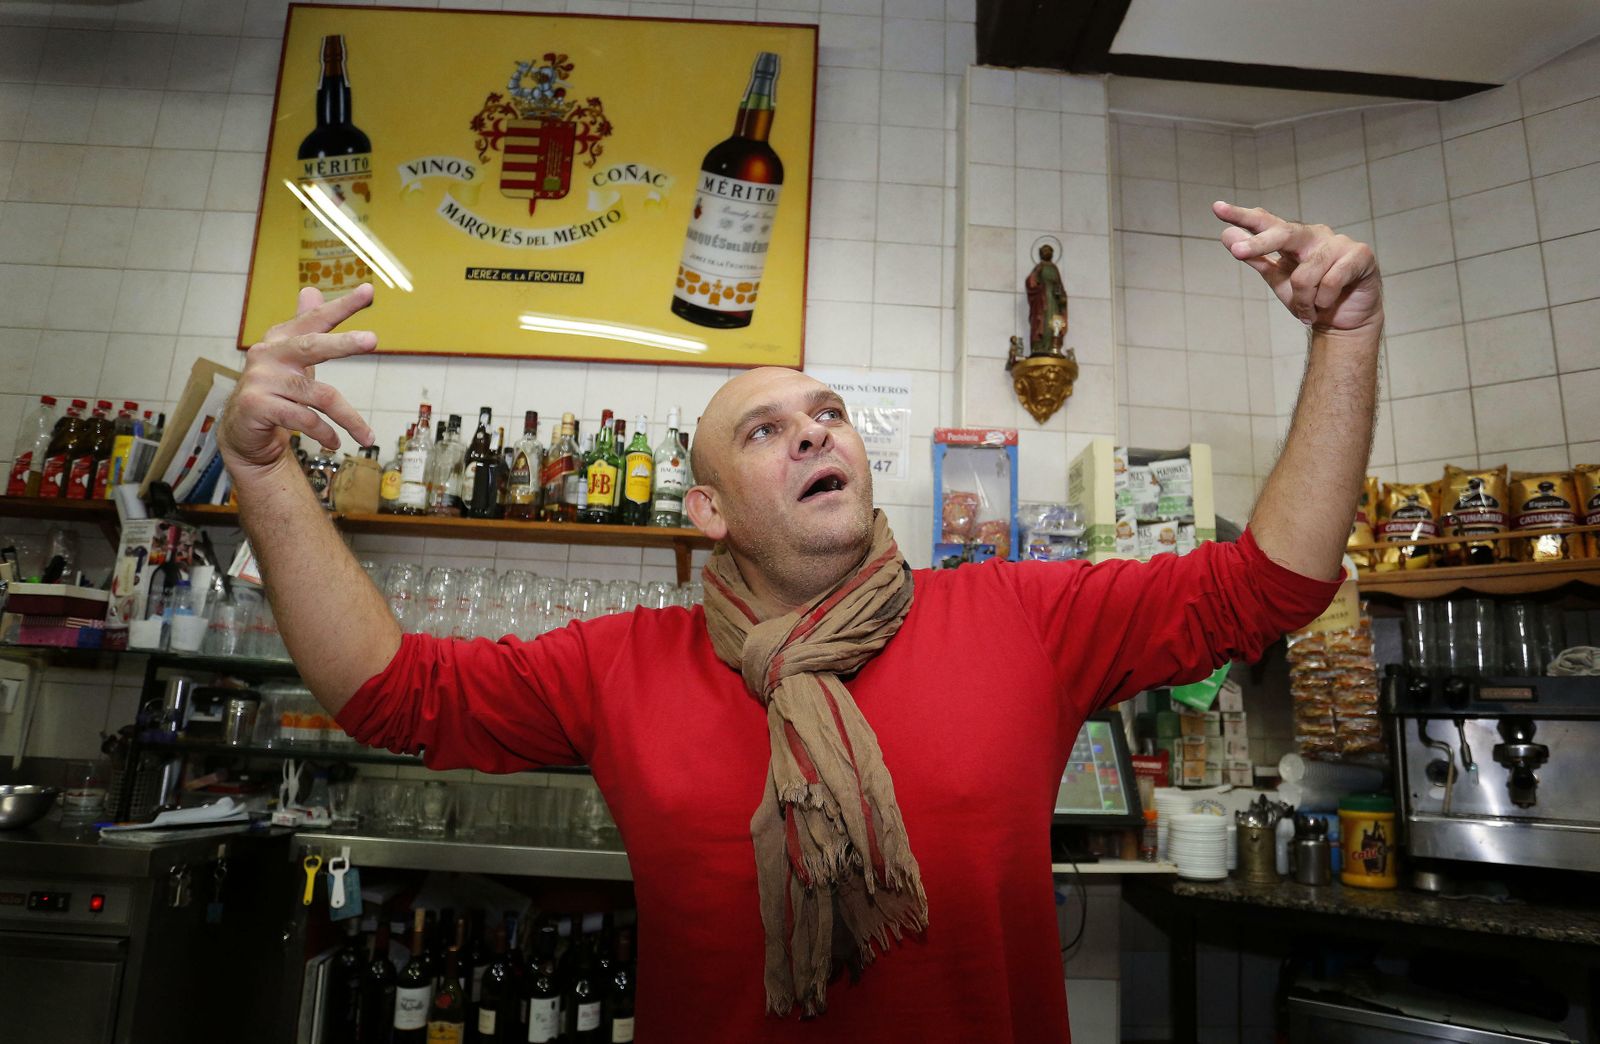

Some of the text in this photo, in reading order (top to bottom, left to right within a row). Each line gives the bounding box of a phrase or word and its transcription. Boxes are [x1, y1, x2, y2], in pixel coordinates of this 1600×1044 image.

[304, 157, 369, 176] MÉRITO
[406, 160, 476, 181] VINOS
[592, 164, 668, 188] COÑAC
[703, 176, 775, 202] MÉRITO
[526, 235, 549, 246] DEL
[553, 208, 621, 245] MÉRITO
[467, 268, 582, 284] JEREZ DE LA FRONTERA
[858, 383, 909, 395] NÚMEROS
[588, 473, 611, 494] J&B
